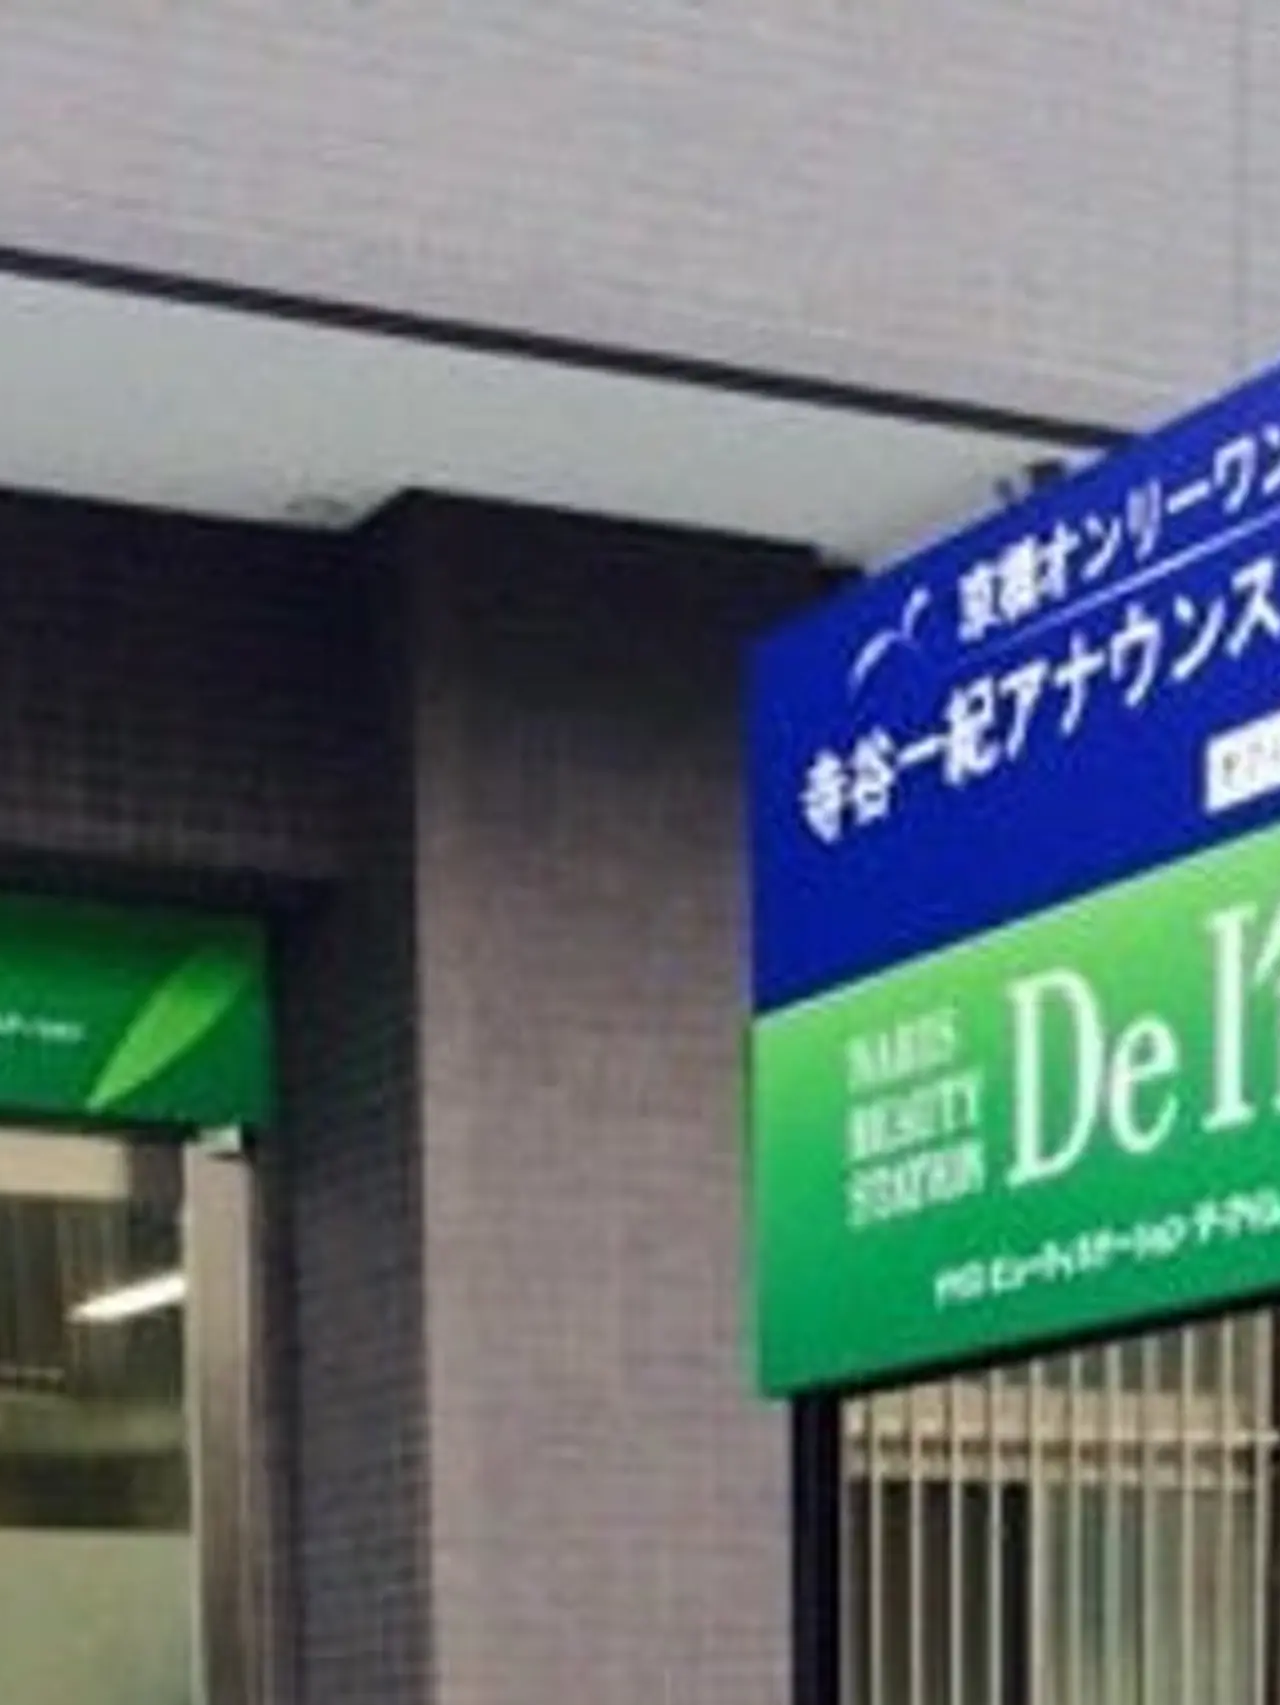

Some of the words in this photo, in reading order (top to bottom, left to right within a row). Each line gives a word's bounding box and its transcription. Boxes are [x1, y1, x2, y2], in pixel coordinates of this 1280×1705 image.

[846, 1070, 986, 1161] BEAUTY
[1005, 966, 1181, 1188] De
[846, 1140, 988, 1229] STATION
